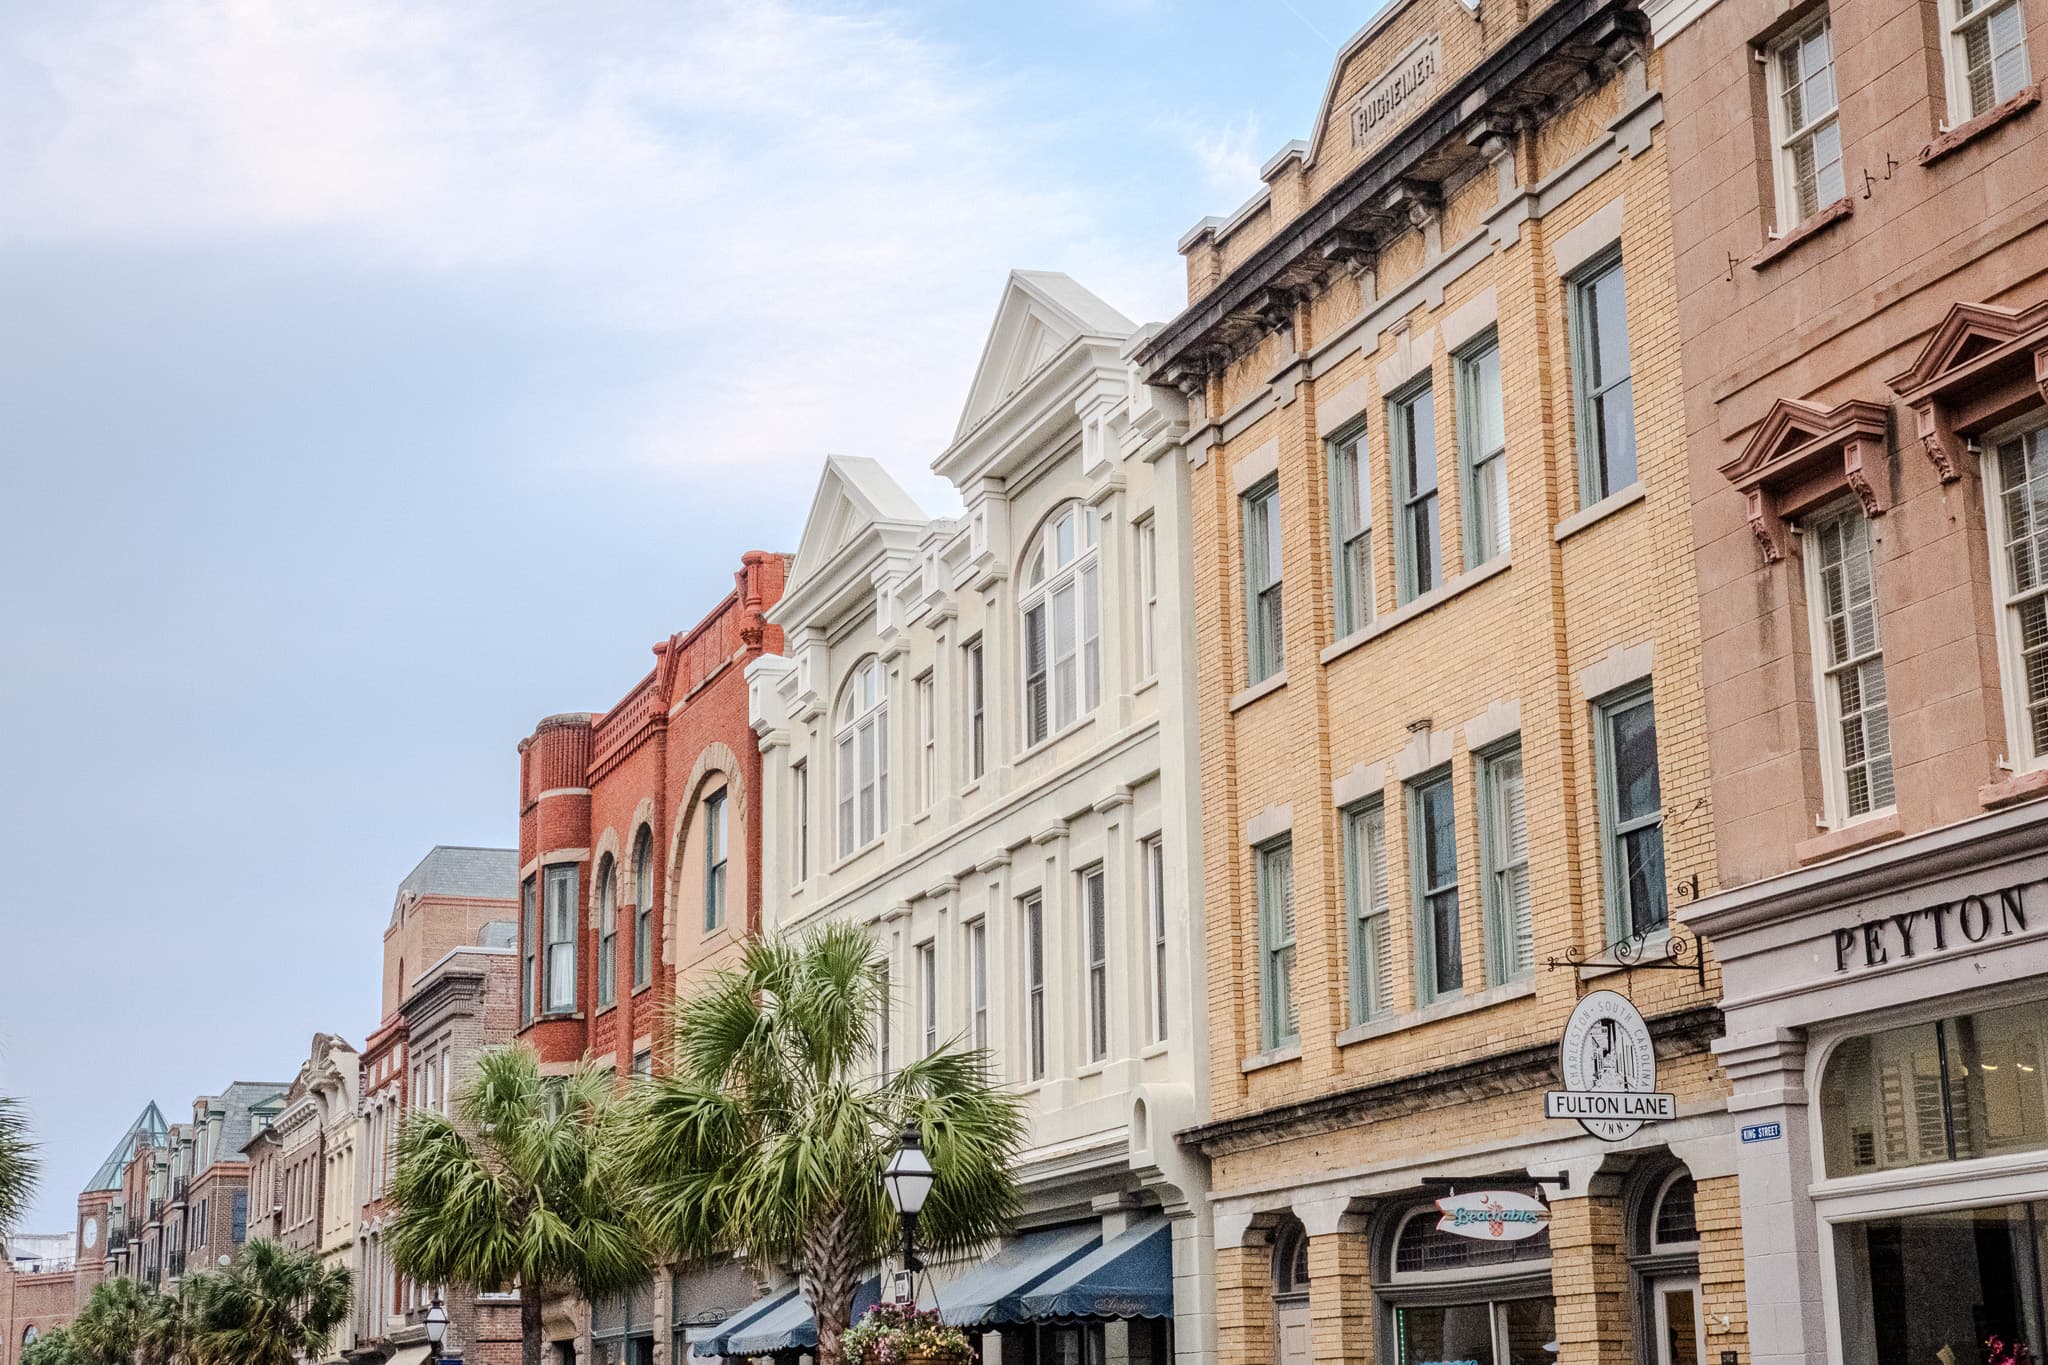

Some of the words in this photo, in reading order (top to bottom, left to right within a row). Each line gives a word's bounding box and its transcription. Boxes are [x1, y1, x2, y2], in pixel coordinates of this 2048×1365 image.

[1832, 883, 2028, 973] PEYTON
[1568, 1010, 1591, 1086] CHARLESTON
[1598, 1001, 1632, 1022] SOUTH
[1633, 1028, 1652, 1088] CAROLINA
[1556, 1096, 1619, 1114] FULTON
[1625, 1097, 1668, 1115] LANE
[1601, 1121, 1624, 1135] INN
[1758, 1125, 1778, 1138] STREET
[1454, 1207, 1539, 1226] Beachables
